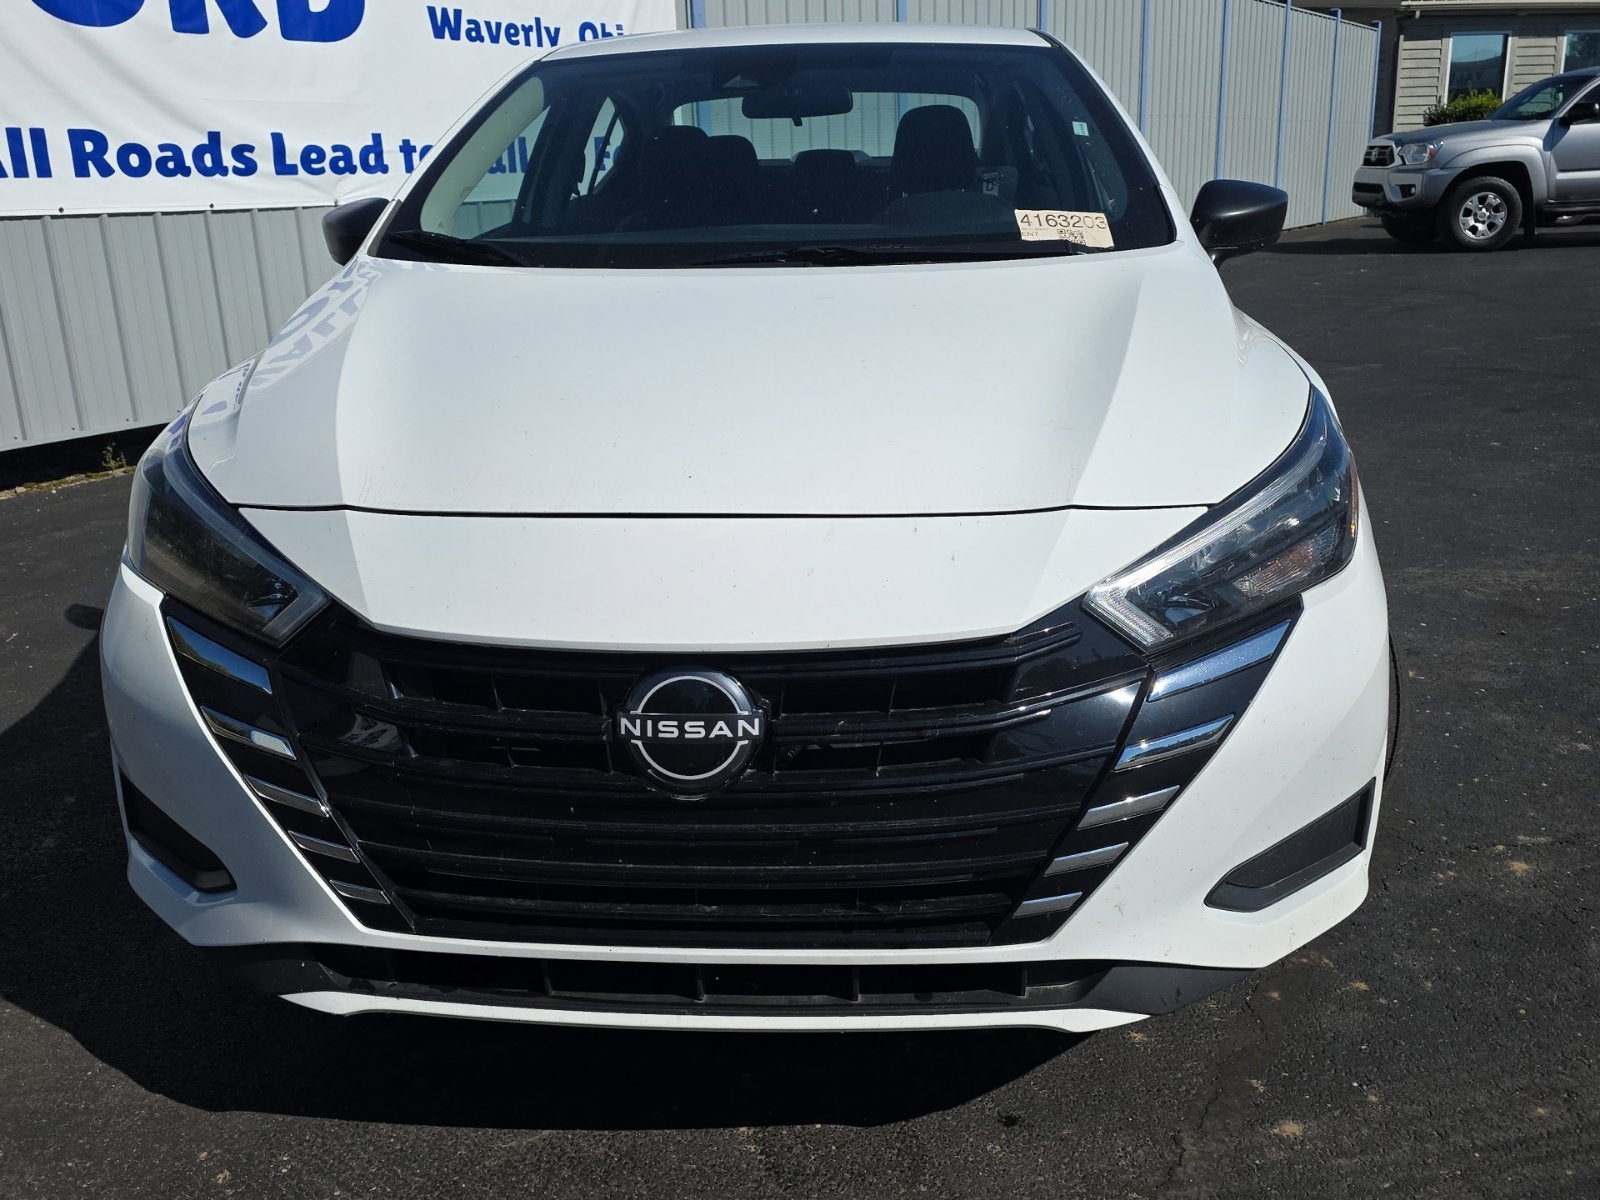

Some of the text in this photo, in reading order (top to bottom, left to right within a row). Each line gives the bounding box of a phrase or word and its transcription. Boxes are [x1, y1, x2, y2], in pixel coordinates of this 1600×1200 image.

[0, 127, 53, 178] ll
[67, 128, 258, 178] Roads
[271, 132, 389, 175] Lead
[1020, 213, 1107, 229] 4163203
[620, 717, 760, 739] NISSAN
